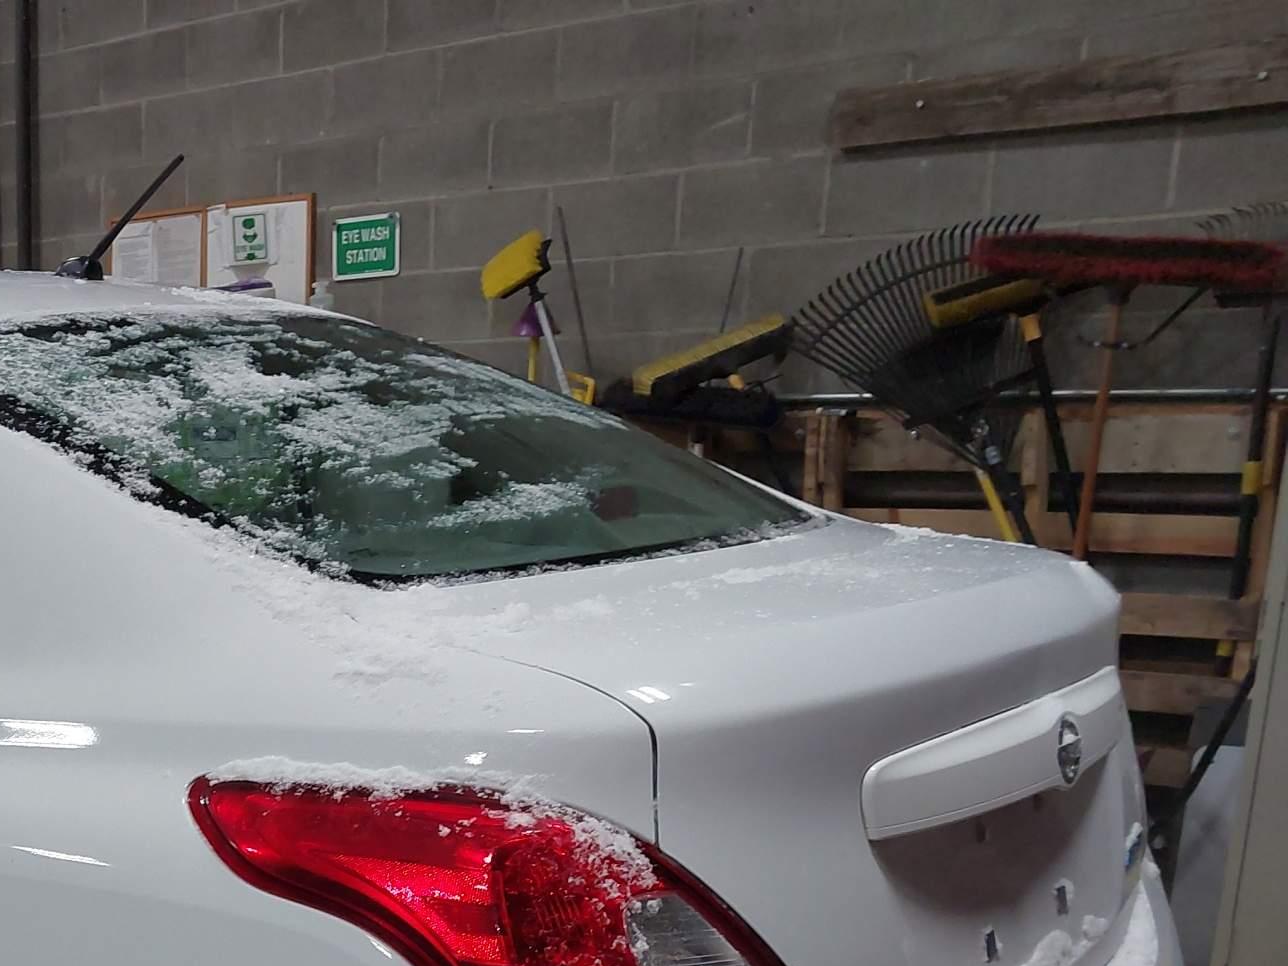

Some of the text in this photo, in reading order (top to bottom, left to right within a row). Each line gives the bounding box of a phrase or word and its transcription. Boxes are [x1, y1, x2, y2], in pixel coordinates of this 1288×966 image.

[341, 226, 389, 245] EYE WASH
[345, 246, 387, 265] STATION
